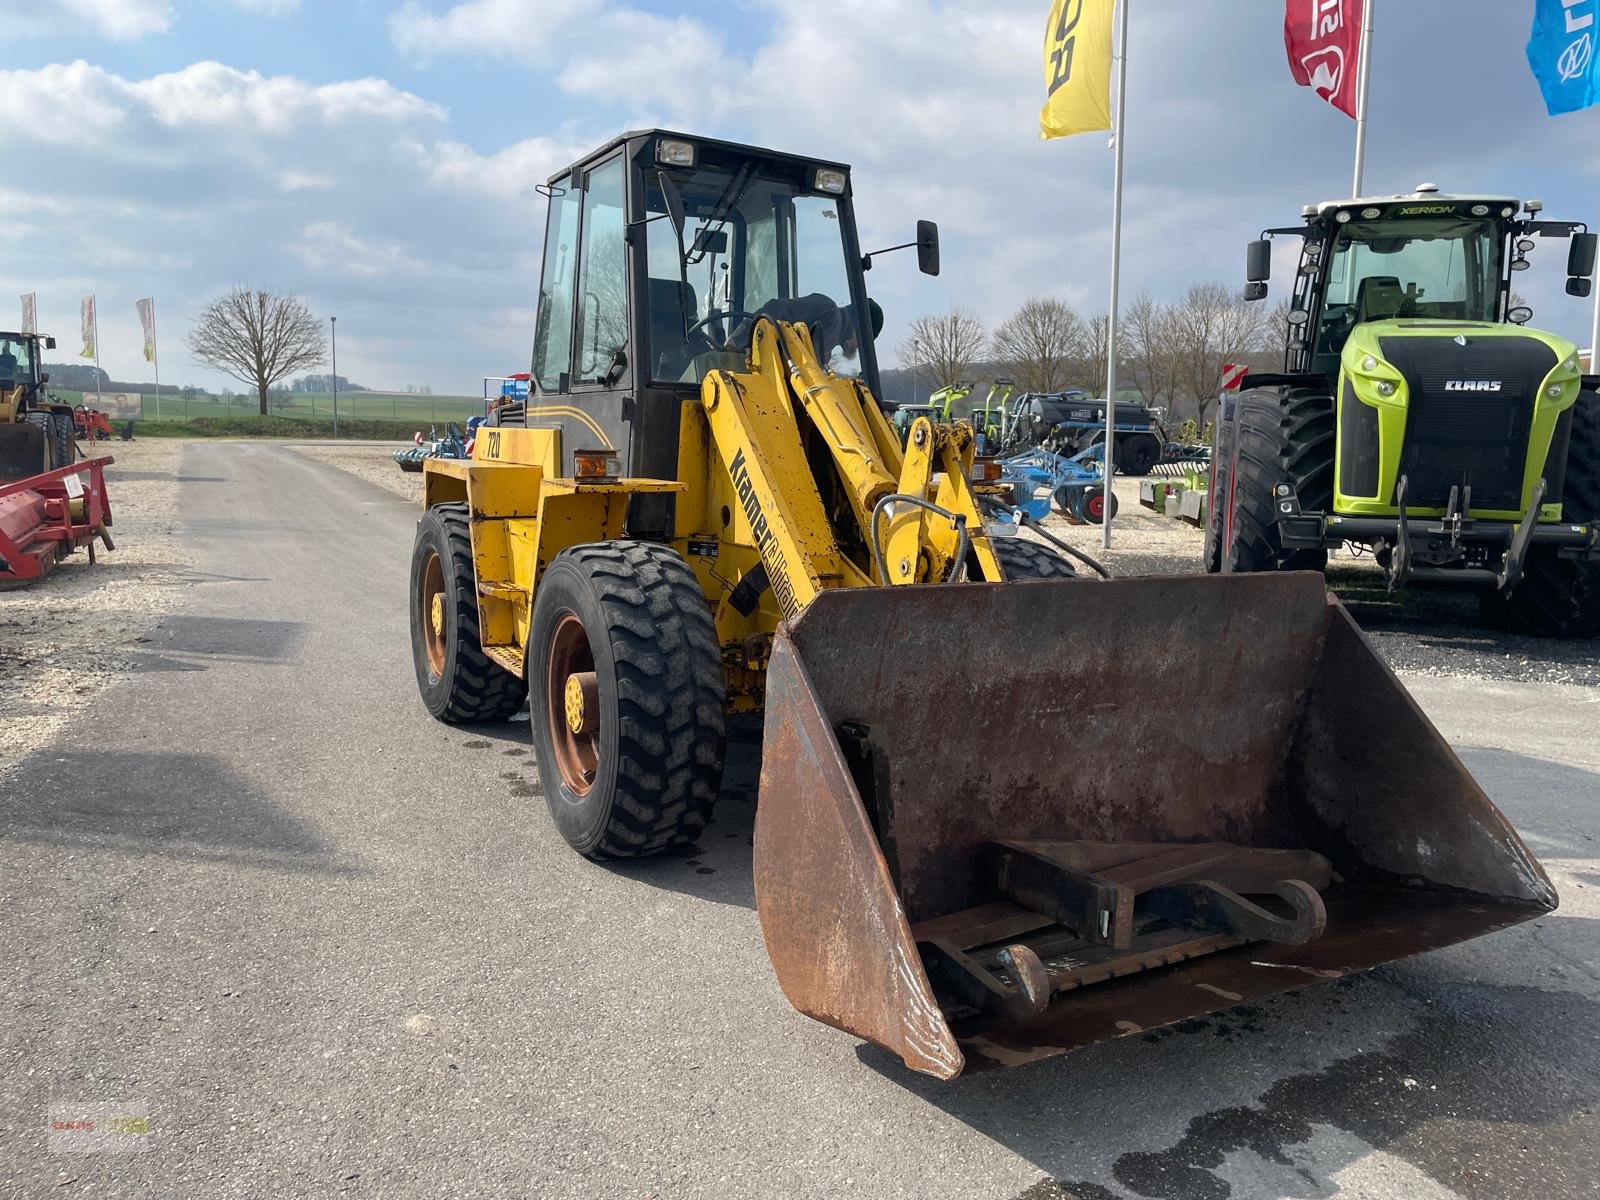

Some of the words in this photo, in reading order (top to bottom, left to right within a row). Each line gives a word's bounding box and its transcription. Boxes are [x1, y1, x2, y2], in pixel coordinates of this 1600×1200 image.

[1400, 206, 1456, 215] XERION
[1444, 380, 1502, 391] CLAAS
[487, 431, 501, 459] 720
